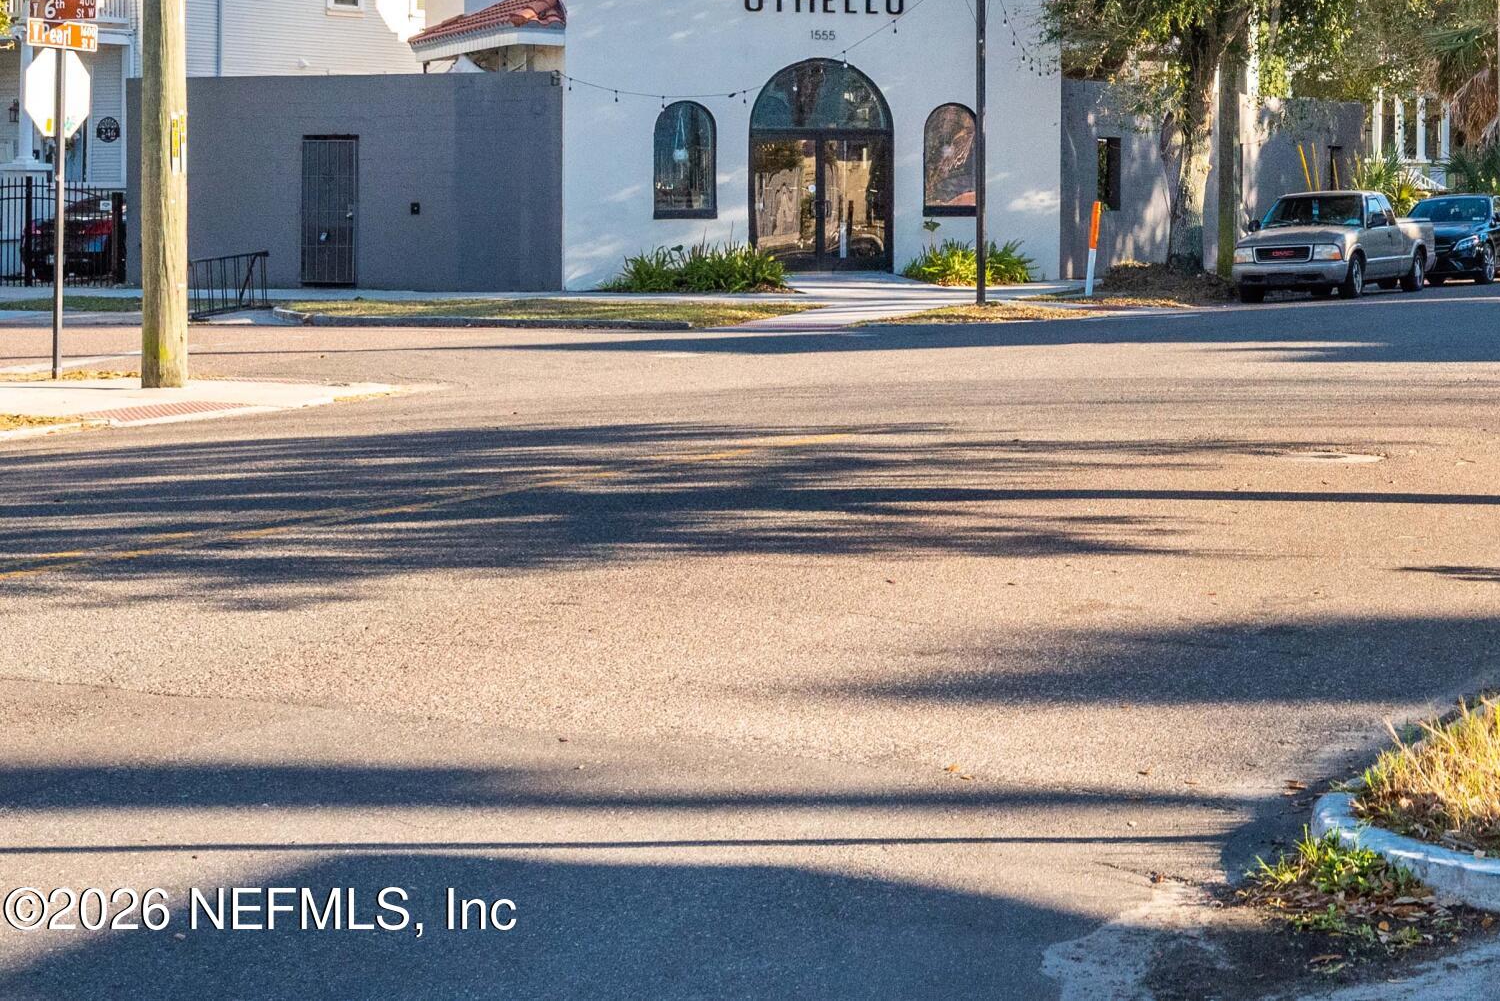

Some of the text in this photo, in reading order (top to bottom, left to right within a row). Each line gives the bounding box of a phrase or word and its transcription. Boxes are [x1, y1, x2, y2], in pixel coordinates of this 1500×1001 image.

[45, 0, 65, 19] 6th
[76, 8, 95, 18] St W
[42, 23, 72, 46] Pearl
[811, 30, 836, 41] 1555
